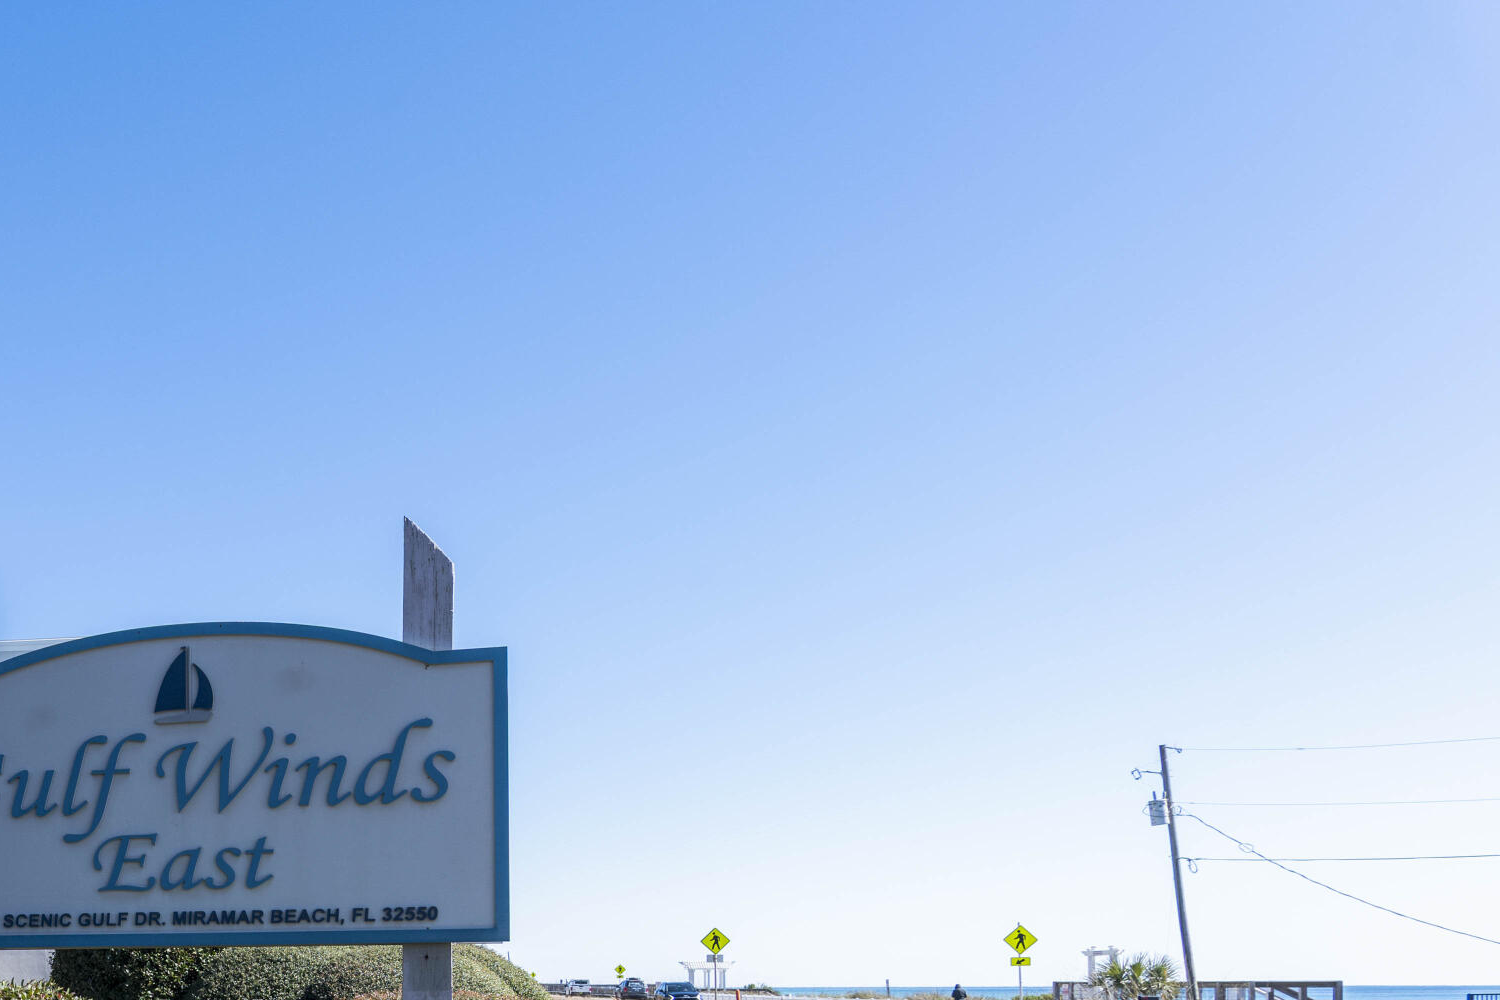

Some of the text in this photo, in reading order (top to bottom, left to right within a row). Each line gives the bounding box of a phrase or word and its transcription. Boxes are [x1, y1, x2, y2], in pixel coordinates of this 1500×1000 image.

[155, 718, 456, 814] Winds
[93, 833, 275, 893] East
[3, 913, 72, 929] SCENIC
[77, 911, 129, 928] GULF
[134, 911, 167, 928] DR.
[171, 909, 265, 927] MIRAMAR
[270, 908, 345, 926] BEACH,
[351, 907, 376, 925] FL
[382, 905, 439, 923] 32550
